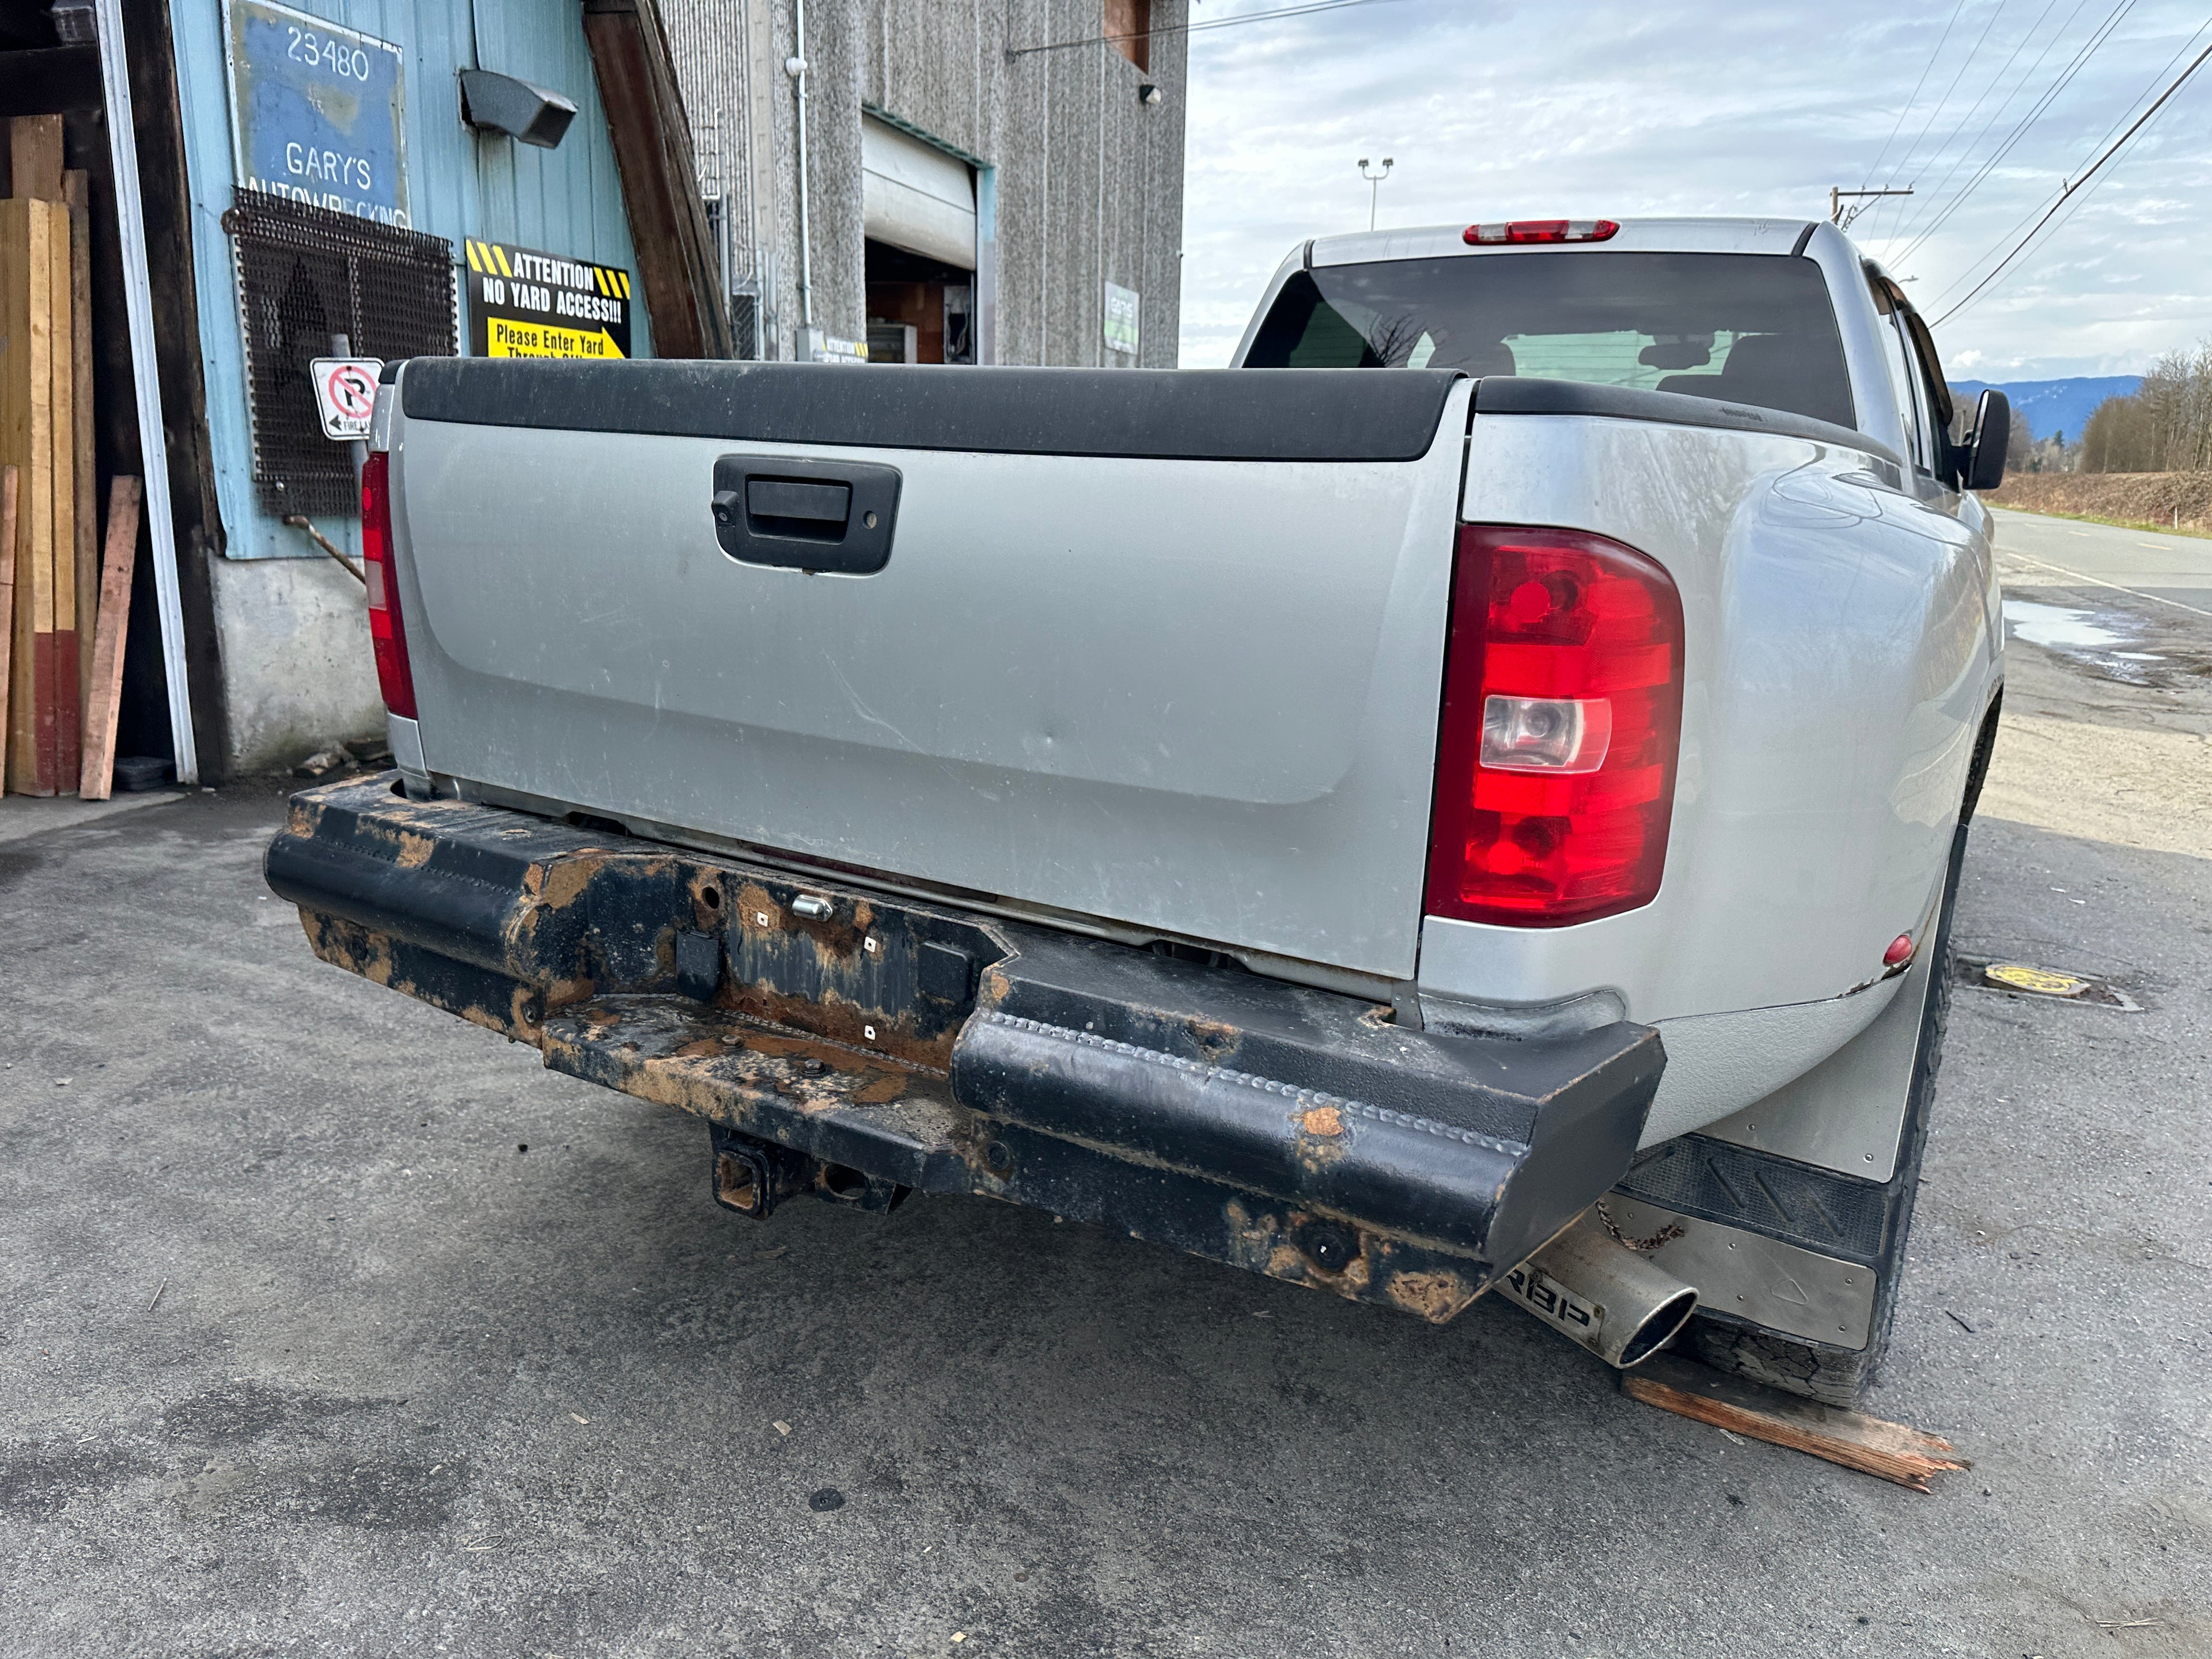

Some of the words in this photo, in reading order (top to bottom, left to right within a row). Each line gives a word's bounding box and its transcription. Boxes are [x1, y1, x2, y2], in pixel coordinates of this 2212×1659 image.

[287, 26, 369, 81] 23480
[287, 142, 371, 190] GARY'S
[513, 252, 594, 291] ATTENTION
[483, 276, 505, 305] NO
[510, 282, 551, 312] YARD
[556, 290, 622, 324] ACCESS!!!
[497, 324, 538, 347] Please
[543, 330, 575, 353] Enter
[579, 334, 604, 356] Yard
[343, 421, 359, 431] FIRE
